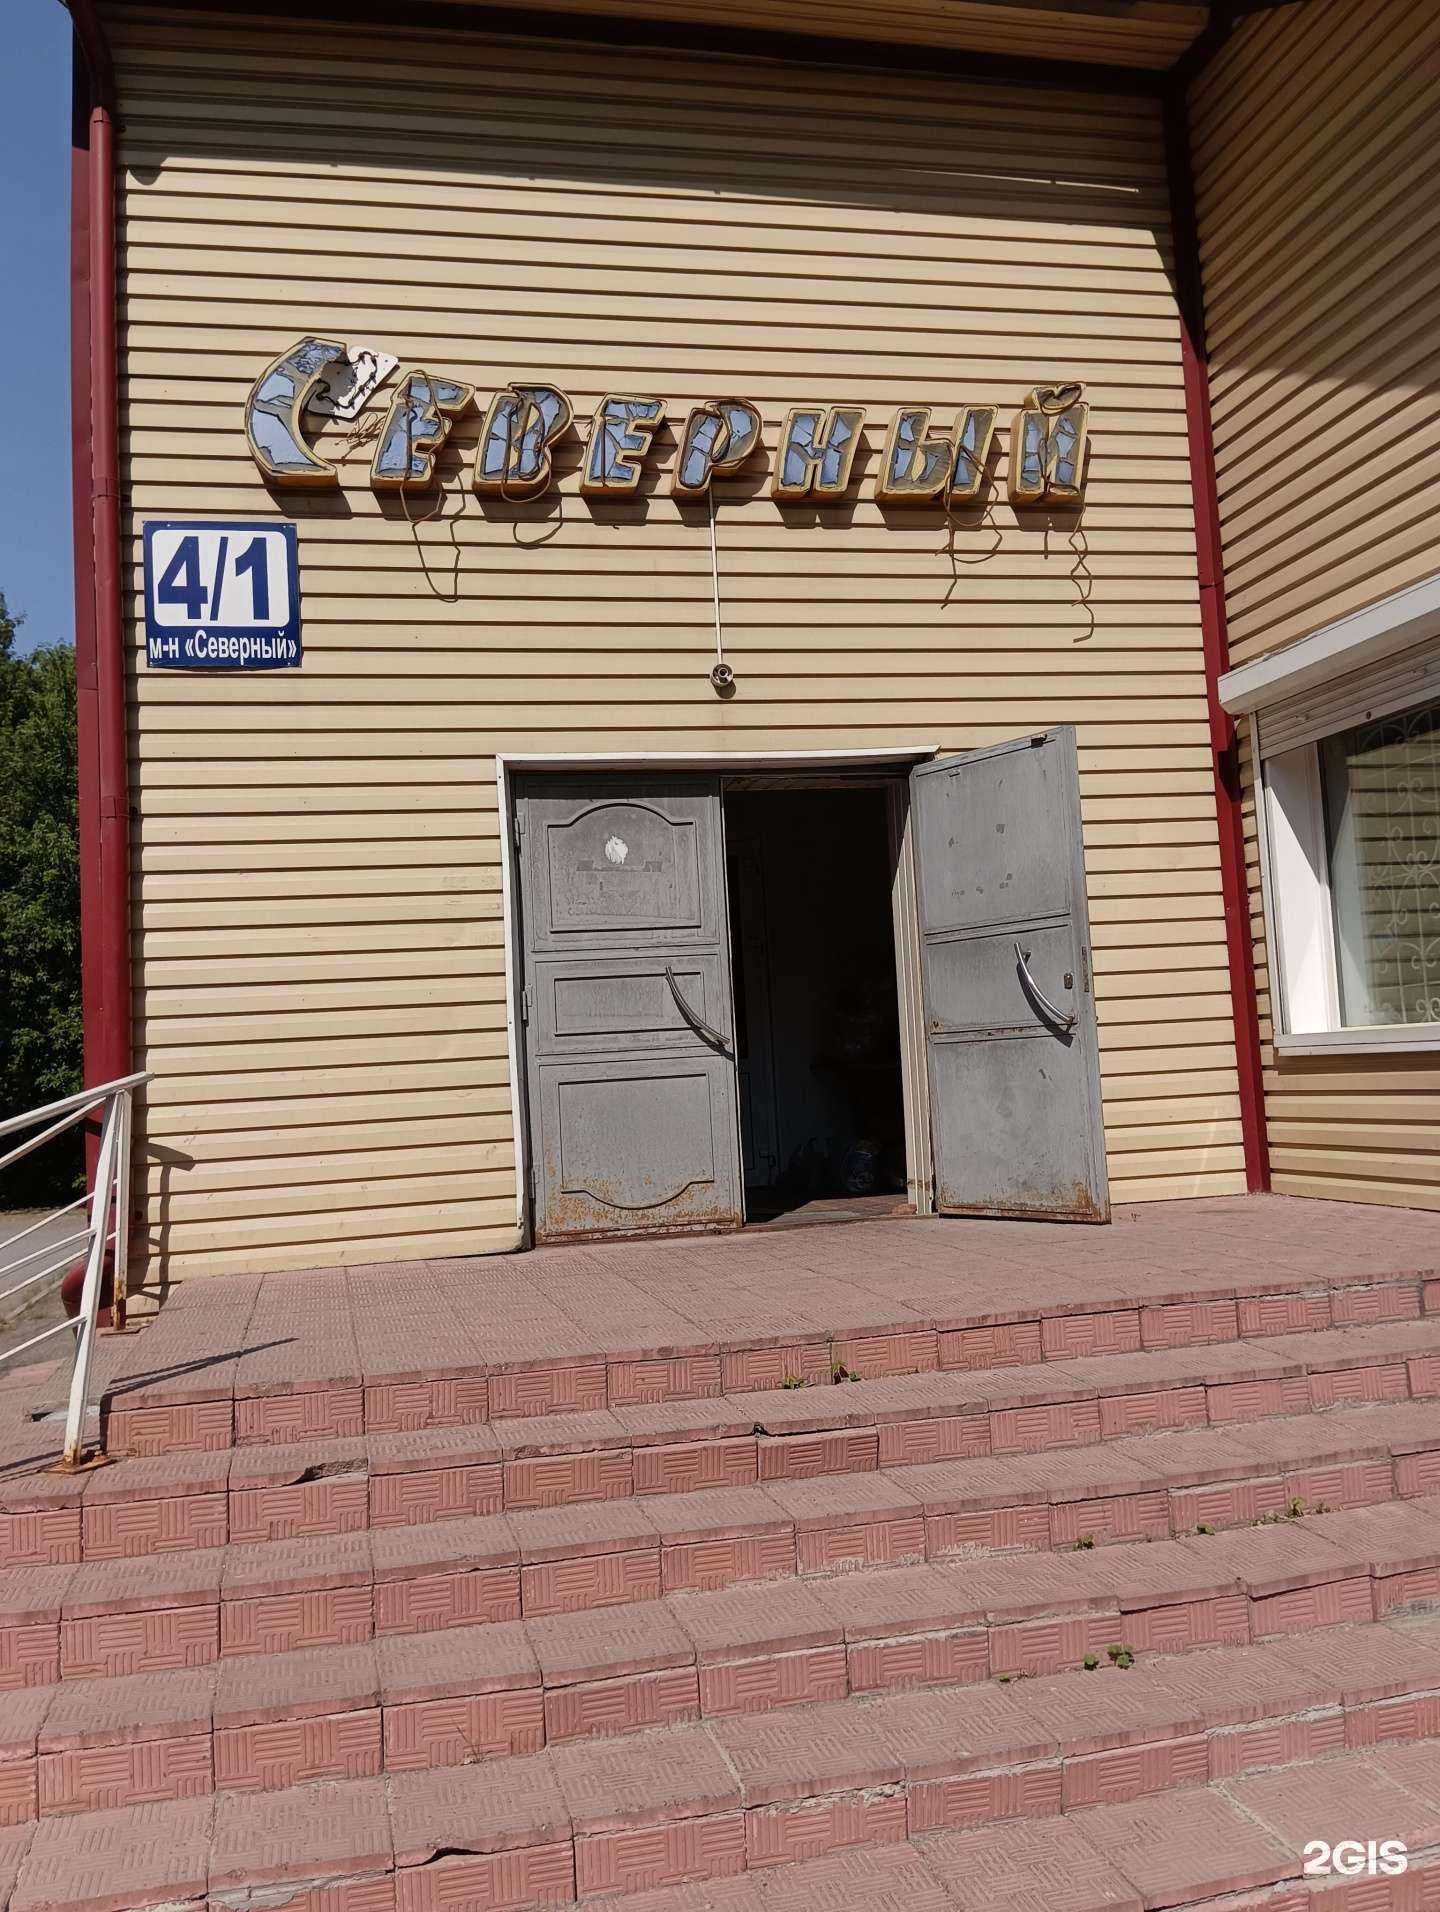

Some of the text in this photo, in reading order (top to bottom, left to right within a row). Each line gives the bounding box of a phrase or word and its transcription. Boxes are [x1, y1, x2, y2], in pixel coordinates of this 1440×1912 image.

[245, 336, 1090, 502] СЕВЕРНЫЙ
[157, 536, 270, 621] 4/1
[149, 629, 297, 665] м-н «Северный»
